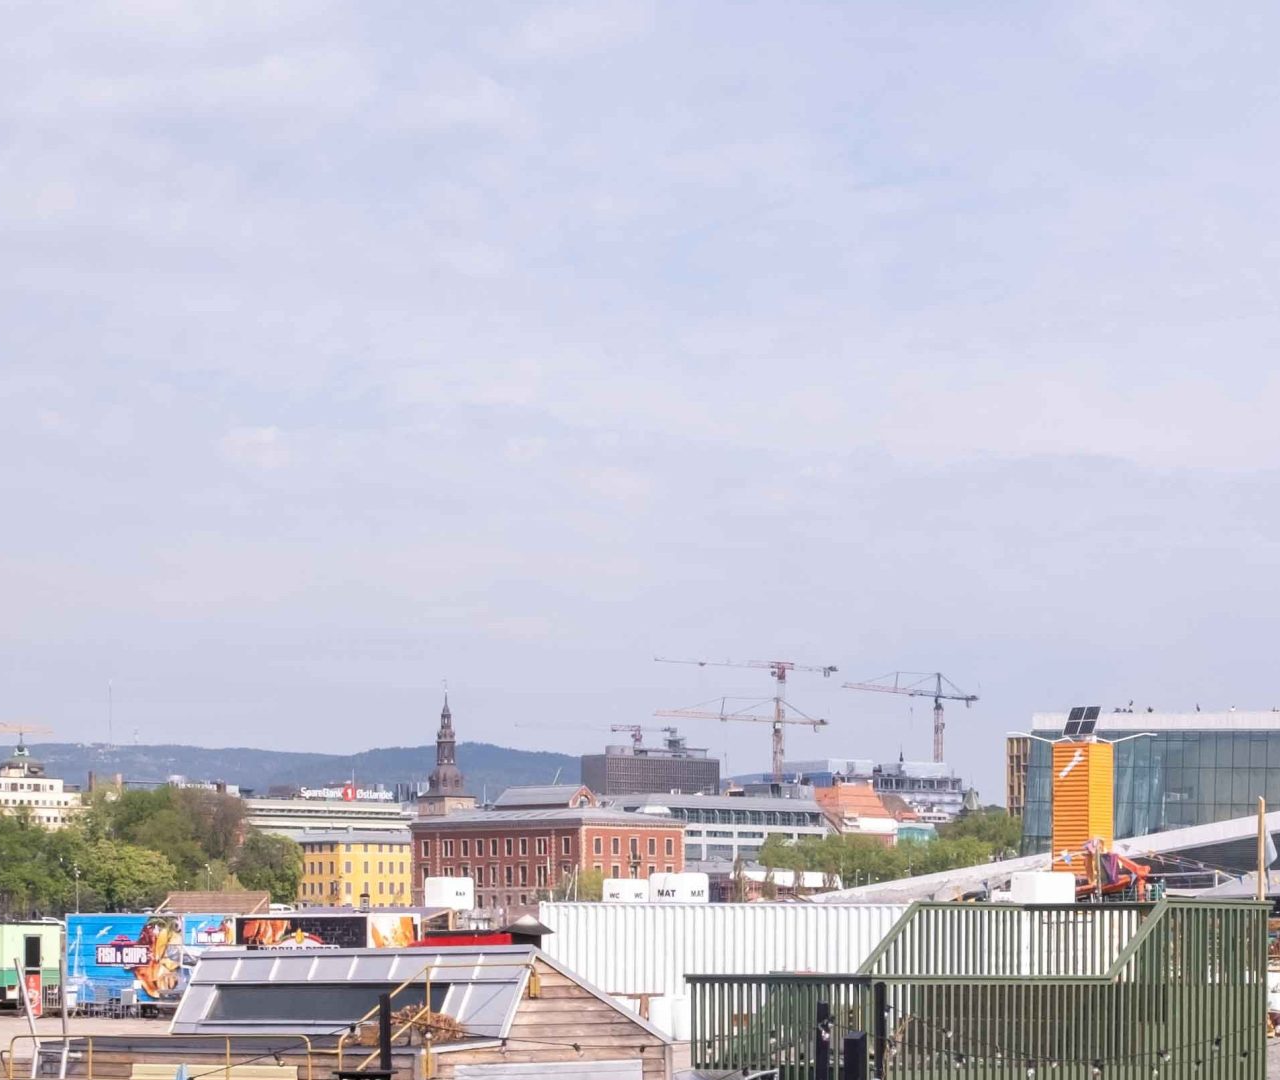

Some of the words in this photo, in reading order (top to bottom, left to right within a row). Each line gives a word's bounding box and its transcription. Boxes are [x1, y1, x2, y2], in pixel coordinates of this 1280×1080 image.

[300, 786, 344, 798] SpareBank
[356, 788, 394, 800] Østlandet
[657, 889, 676, 897] MAT
[98, 947, 116, 963] FISH
[122, 947, 147, 964] CHIPS
